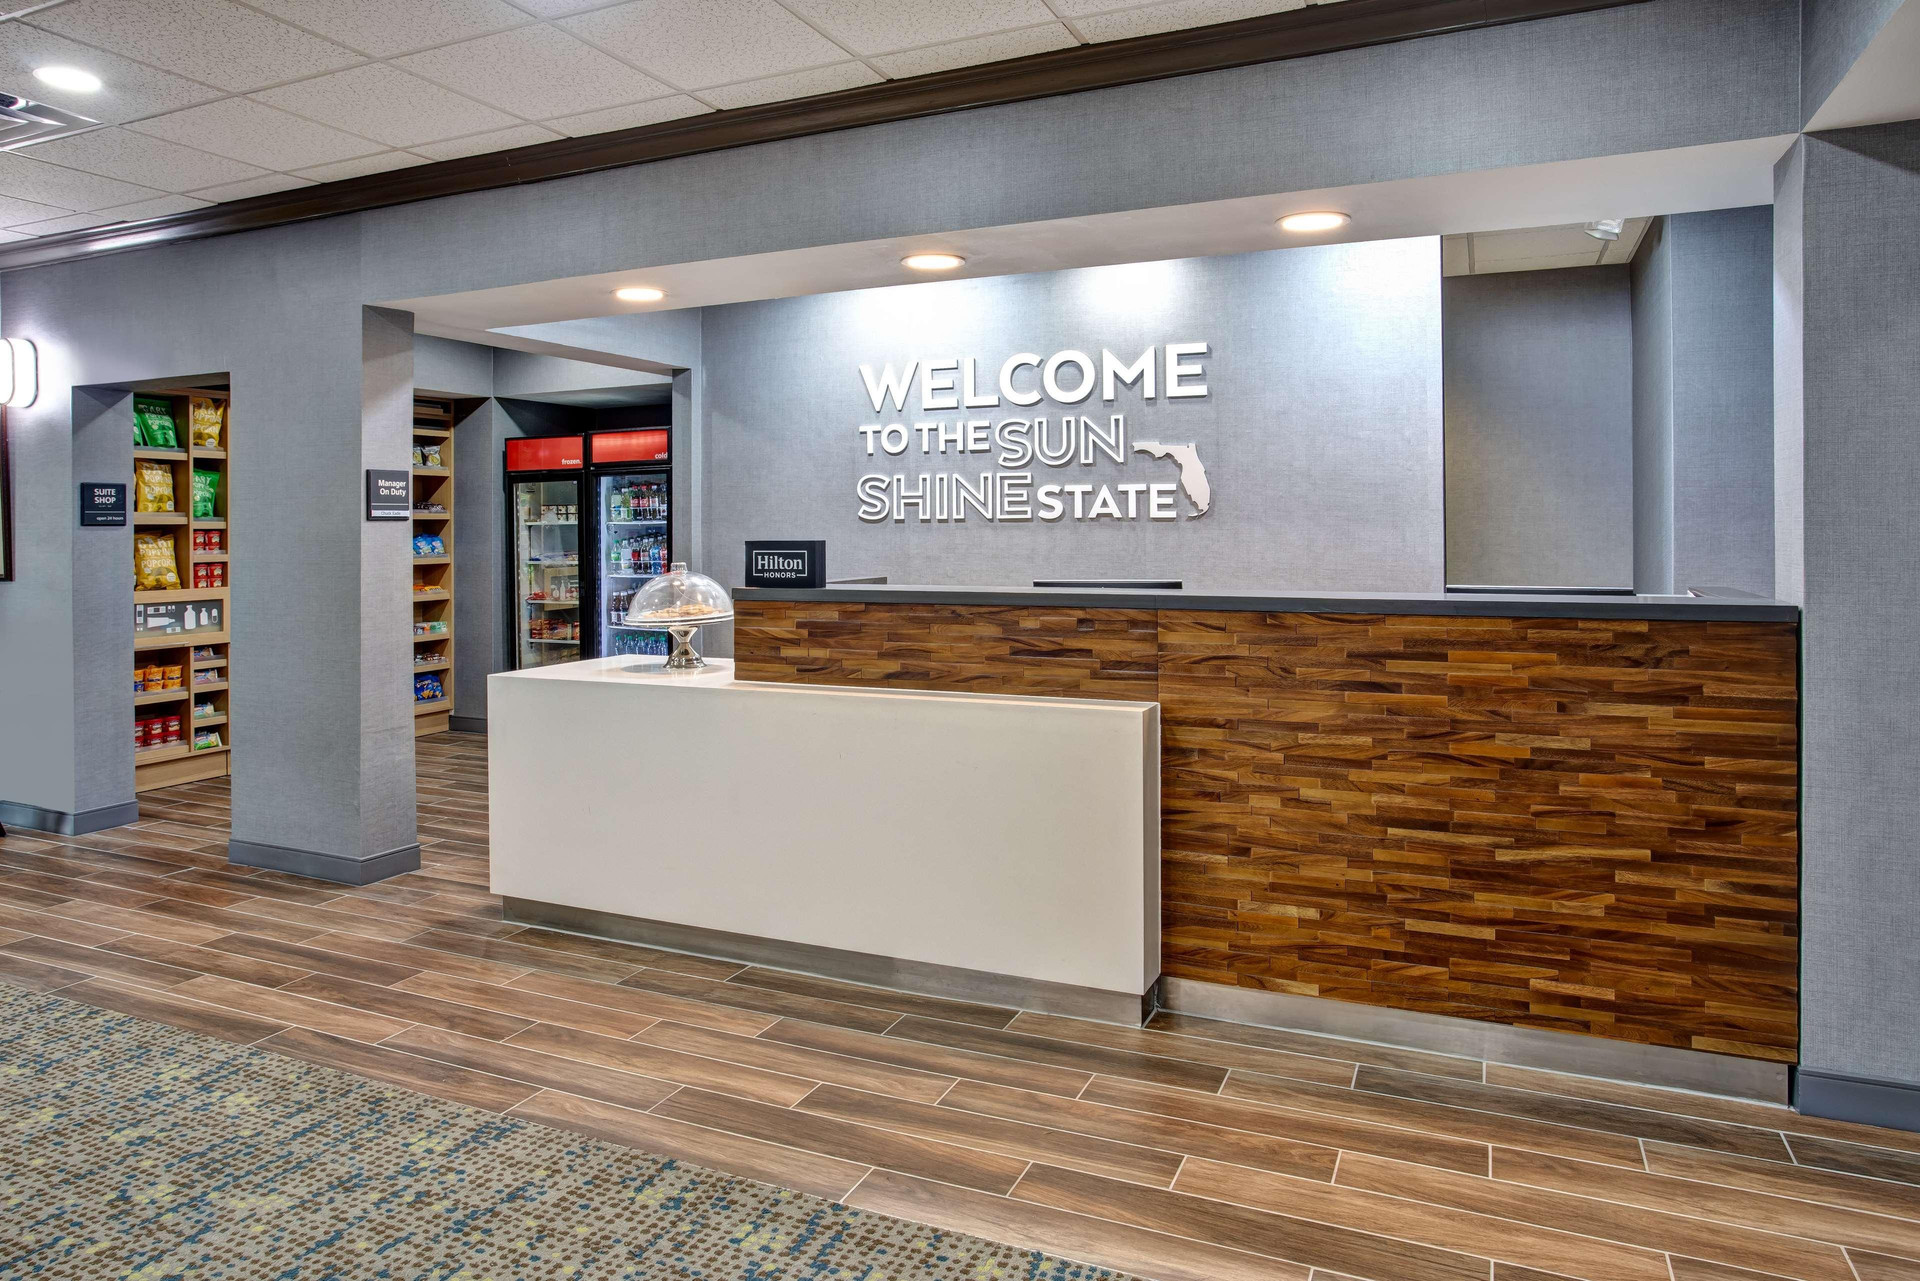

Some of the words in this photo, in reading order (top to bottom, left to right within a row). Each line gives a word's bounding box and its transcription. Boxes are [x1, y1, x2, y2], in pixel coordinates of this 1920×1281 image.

[859, 342, 1209, 412] WELCOME
[859, 424, 909, 455] TO
[914, 420, 991, 453] THE
[995, 414, 1125, 467] SUN
[378, 480, 406, 488] Manager
[391, 488, 406, 497] Duty
[857, 472, 1032, 520] SHINE
[1037, 483, 1177, 520] STATE
[757, 555, 803, 570] Hilton
